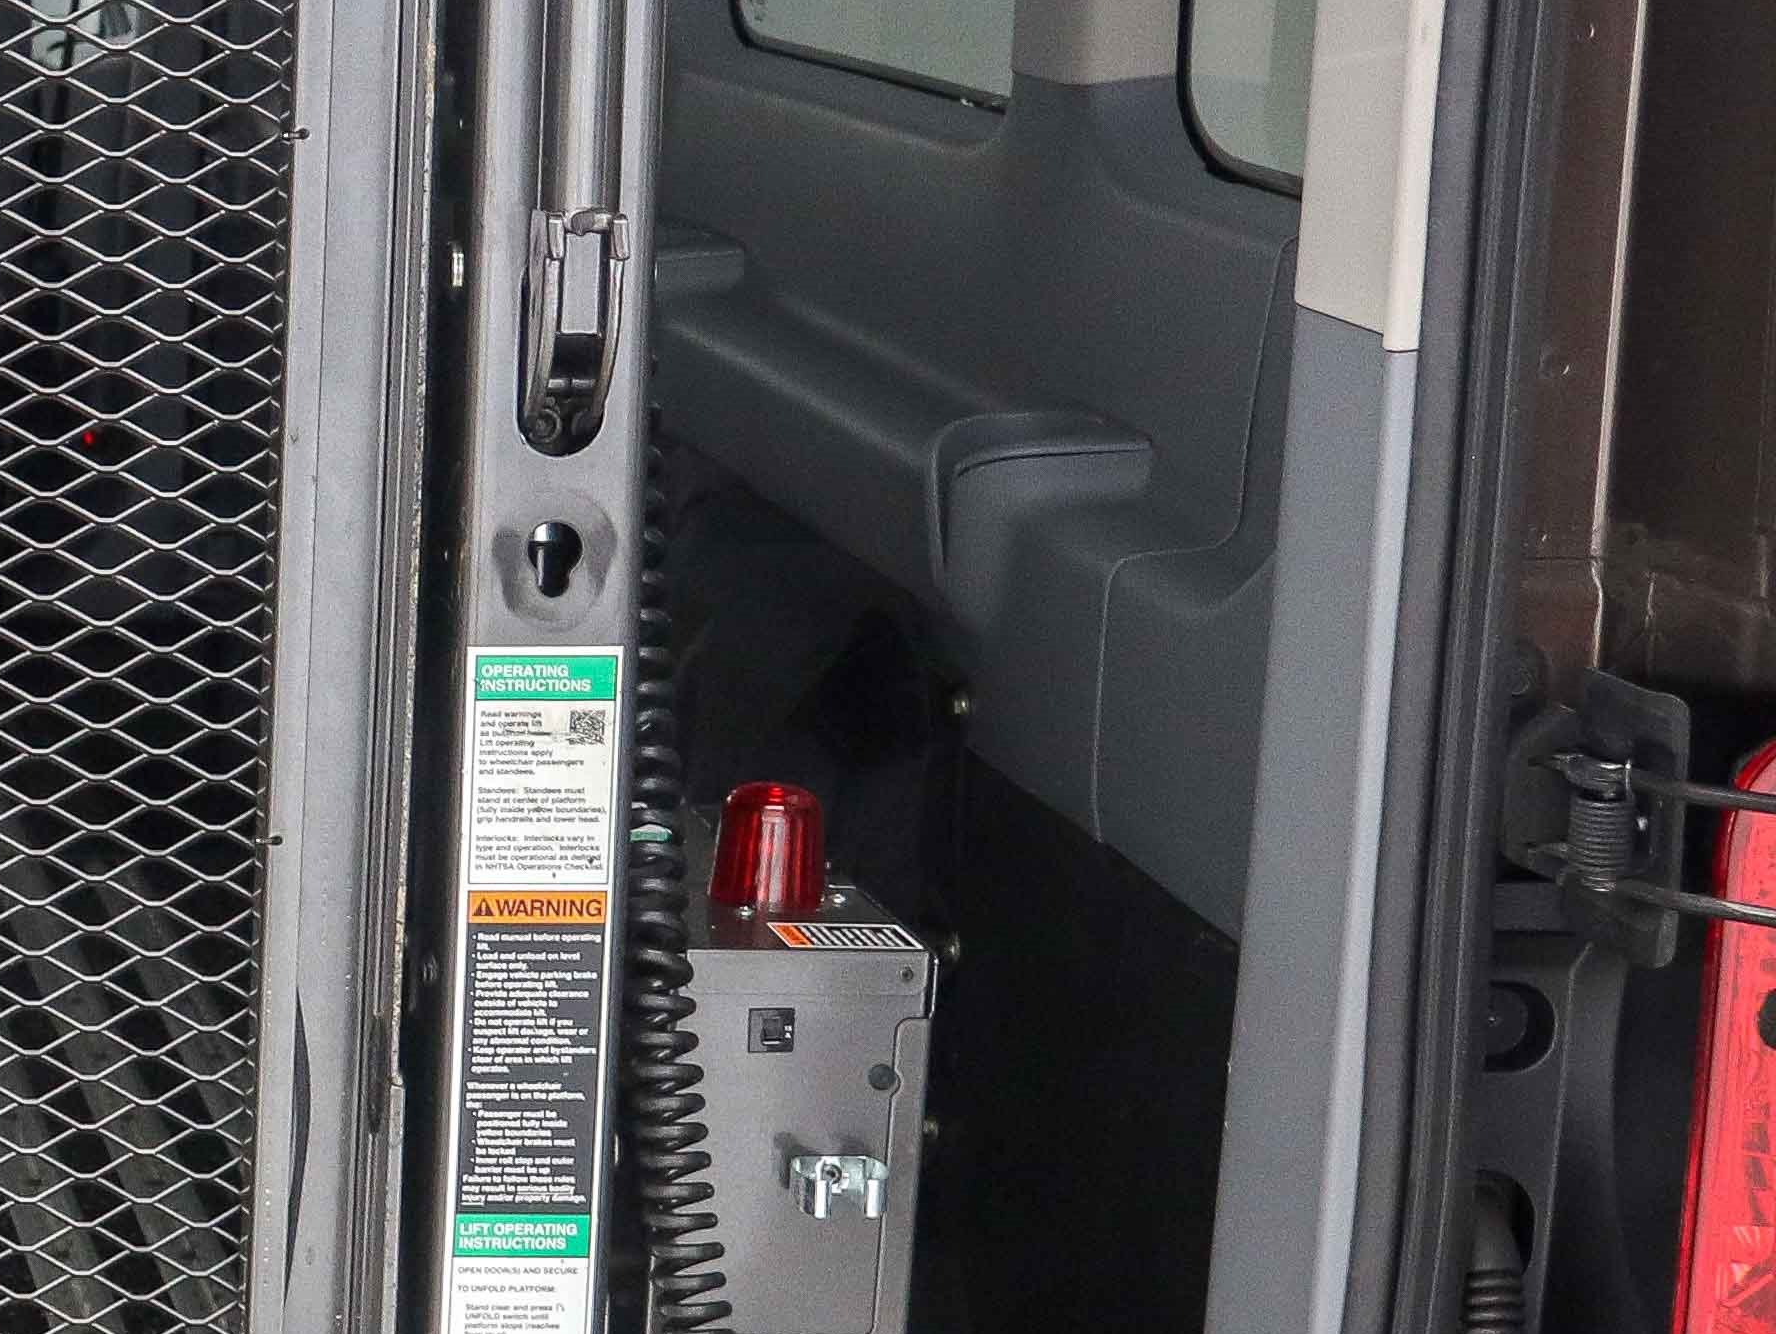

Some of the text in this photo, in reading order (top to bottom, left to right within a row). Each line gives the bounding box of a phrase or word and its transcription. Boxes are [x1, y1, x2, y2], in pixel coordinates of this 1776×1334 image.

[481, 665, 569, 677] OPERATING
[480, 679, 592, 691] INSTRUCTIONS
[496, 899, 602, 916] WARNING
[460, 1223, 578, 1235] LIFT OPERATING
[459, 1237, 567, 1249] INSTRUCTIONS
